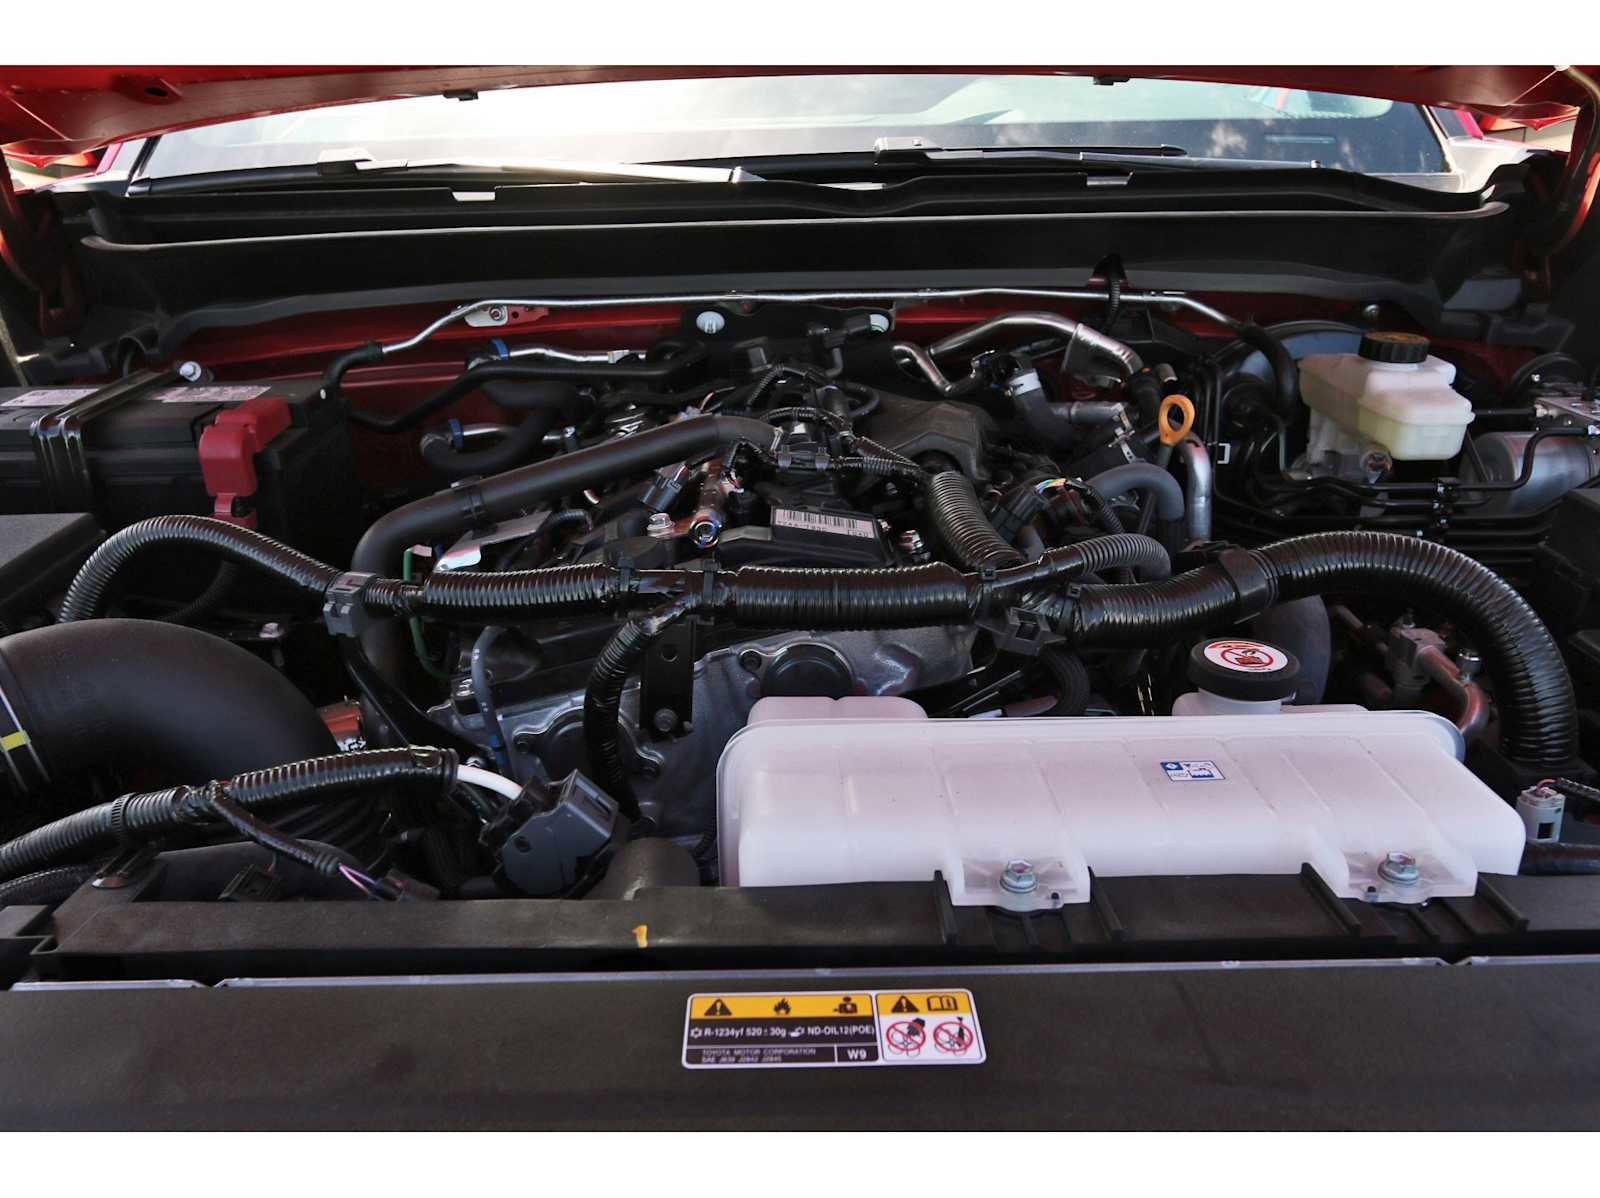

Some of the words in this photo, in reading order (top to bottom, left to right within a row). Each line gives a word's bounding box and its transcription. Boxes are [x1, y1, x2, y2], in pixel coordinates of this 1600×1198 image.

[703, 1027, 743, 1039] R-1234yf
[745, 1027, 762, 1038] 520
[770, 1027, 786, 1039] 30g
[764, 1048, 816, 1056] CORPORATION
[847, 1047, 867, 1060] W9
